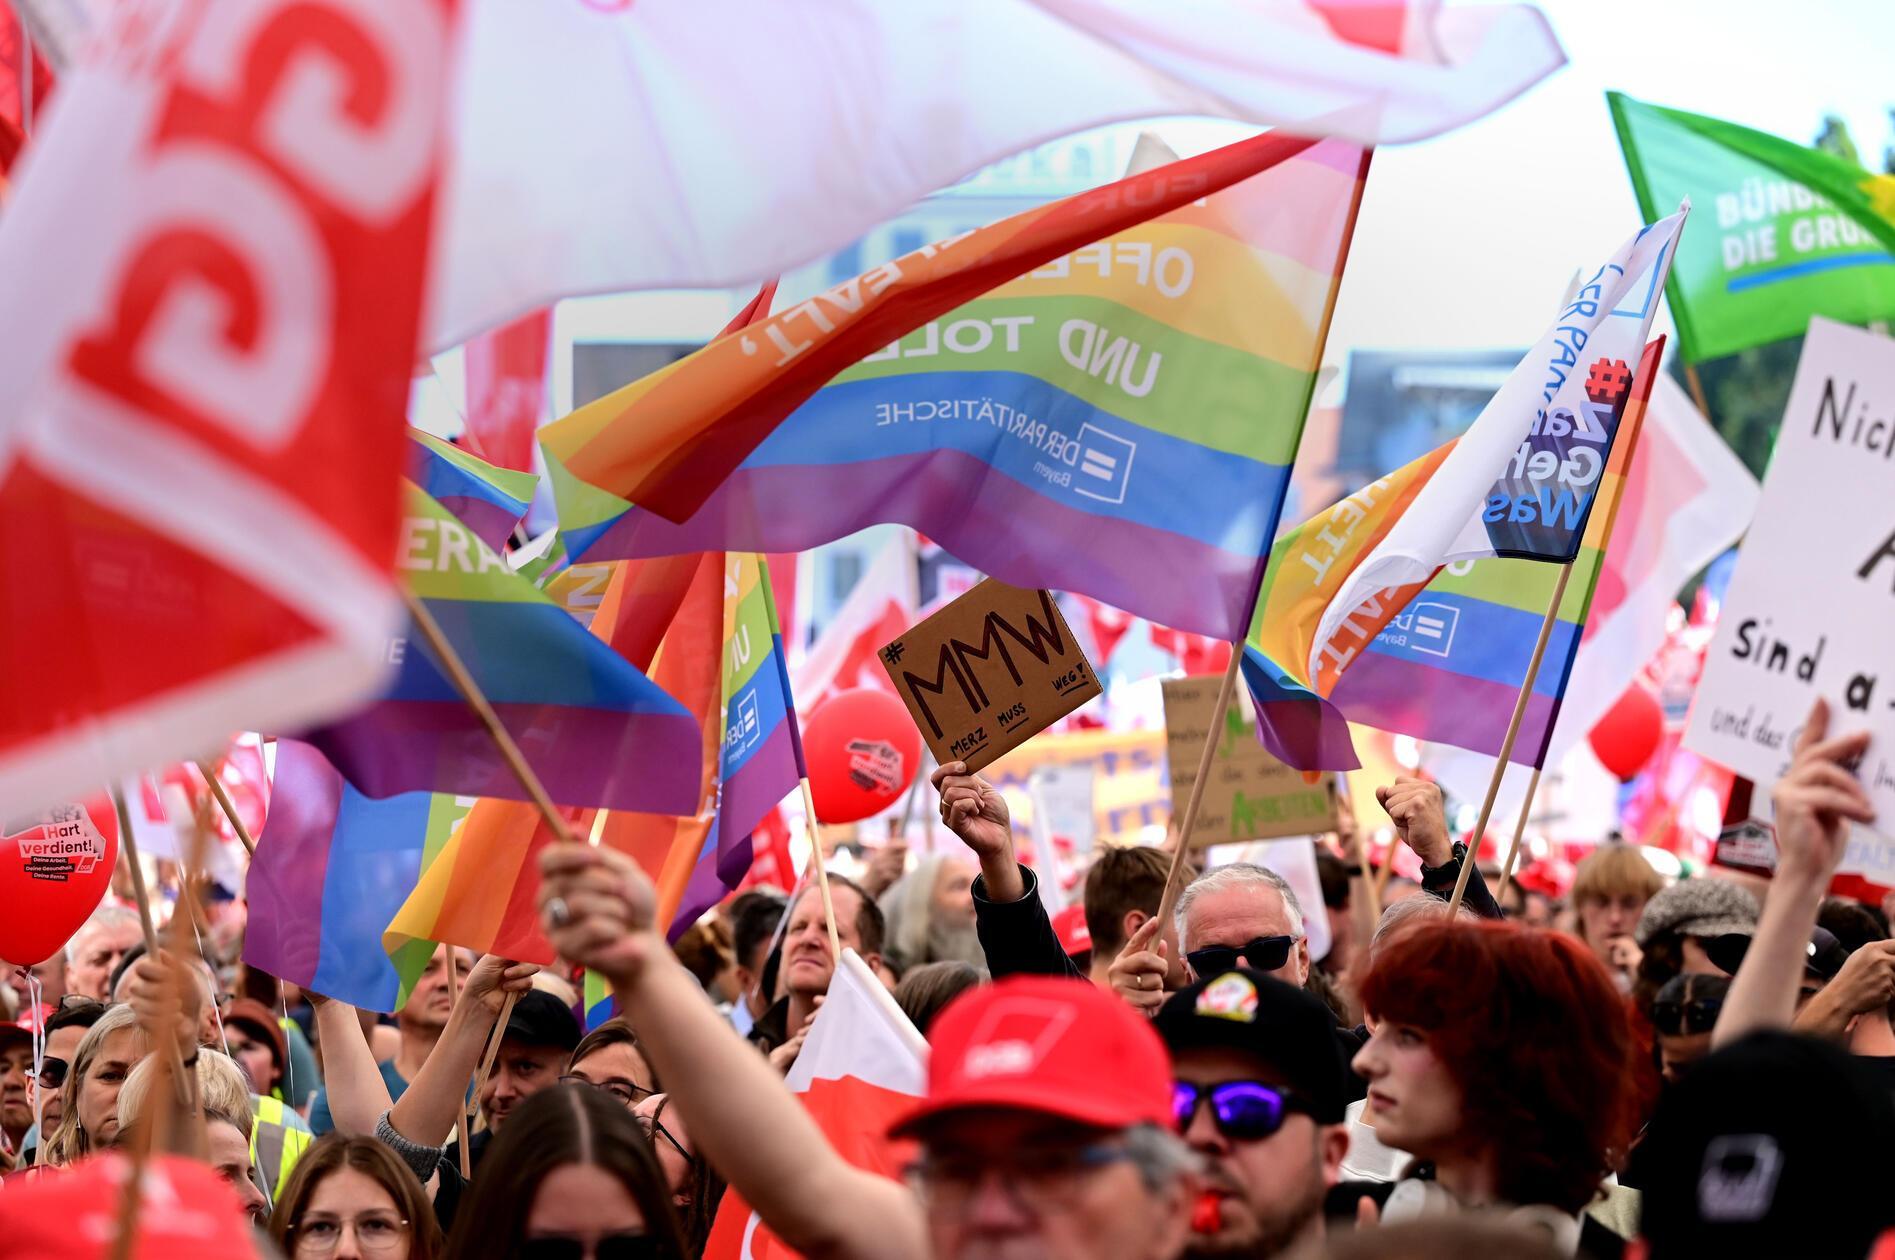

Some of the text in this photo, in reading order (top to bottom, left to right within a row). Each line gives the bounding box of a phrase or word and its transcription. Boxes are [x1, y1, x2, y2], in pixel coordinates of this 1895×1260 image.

[1721, 225, 1779, 272] DIE
[902, 589, 1065, 741] MMW
[1730, 616, 1828, 684] Sind
[950, 726, 988, 759] MERZ
[996, 702, 1027, 728] MUSS
[22, 839, 93, 855] verdient!
[46, 823, 81, 840] Hart
